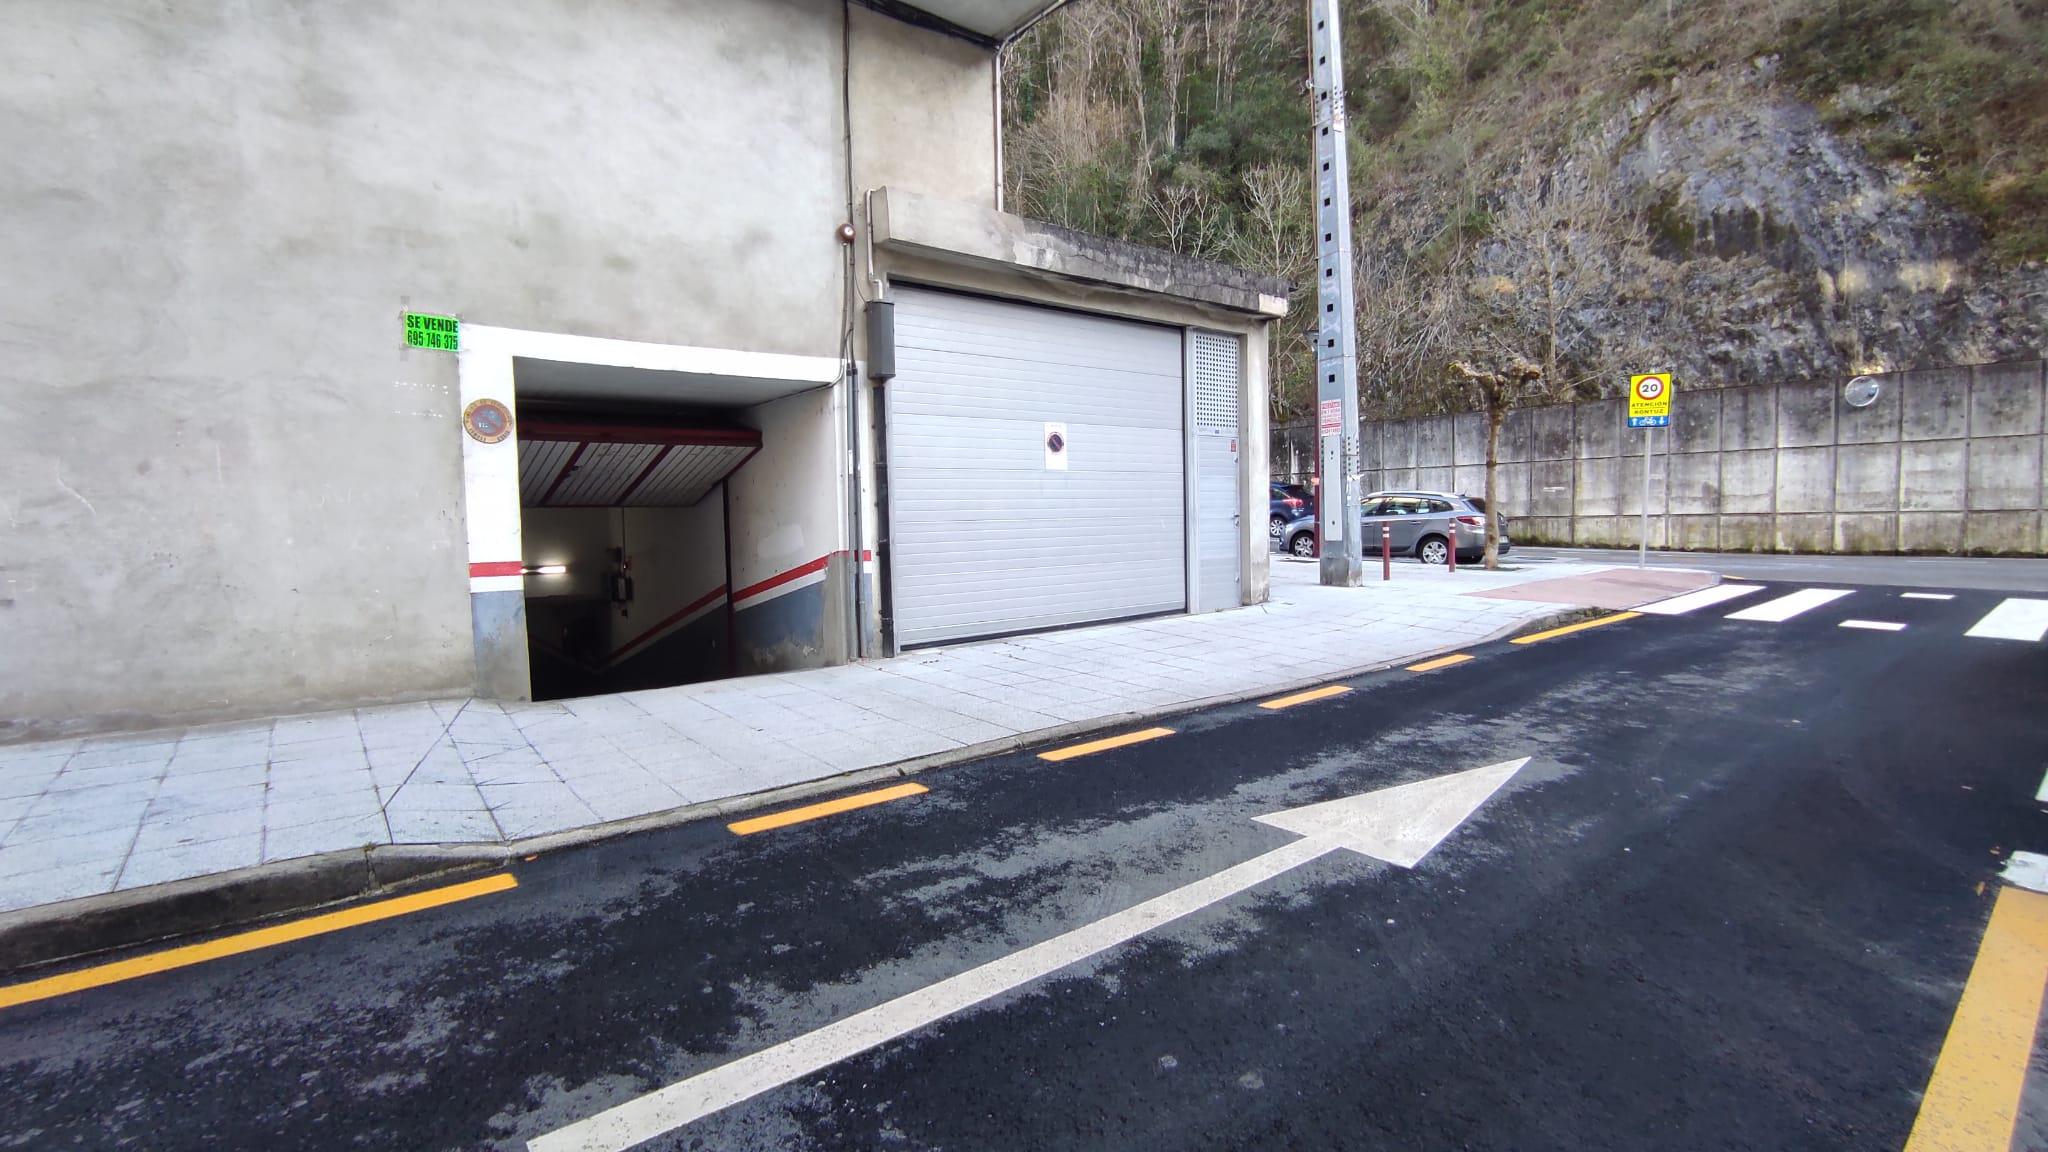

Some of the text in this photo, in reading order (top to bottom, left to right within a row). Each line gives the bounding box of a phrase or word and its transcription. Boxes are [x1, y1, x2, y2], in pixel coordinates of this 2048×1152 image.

[407, 315, 458, 333] SE VENDE
[407, 330, 458, 350] 695 746 375
[1642, 384, 1658, 392] 20
